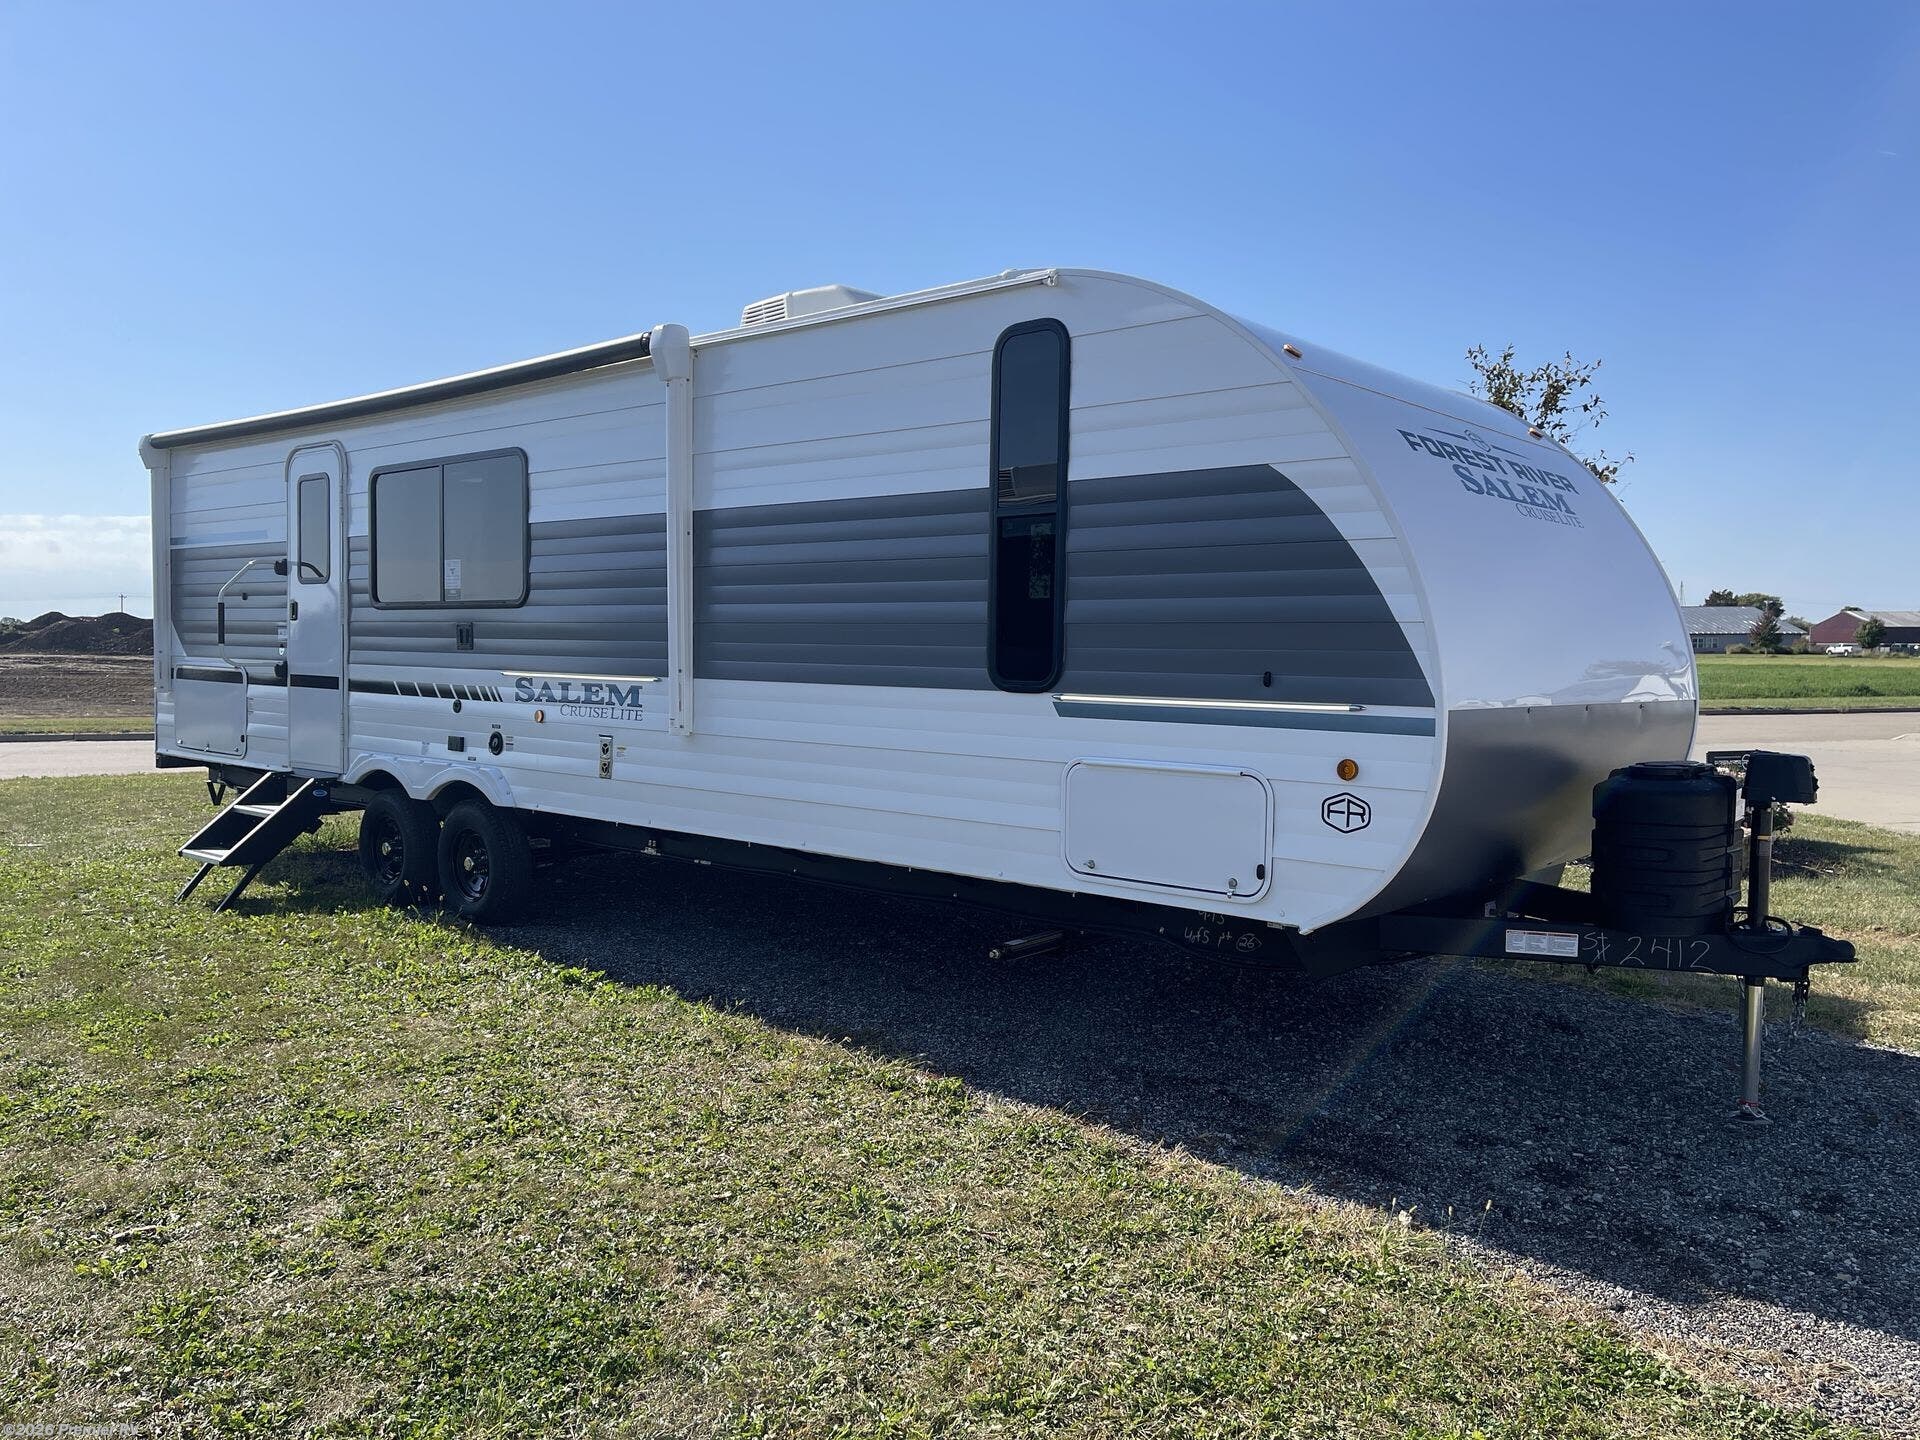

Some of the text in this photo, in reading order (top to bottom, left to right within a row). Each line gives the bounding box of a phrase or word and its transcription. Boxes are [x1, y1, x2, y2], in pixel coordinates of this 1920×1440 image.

[1396, 429, 1580, 495] FOREST RIVER
[1452, 463, 1576, 515] SALEM
[514, 677, 643, 708] SALEM
[560, 703, 644, 722] CRUISELITE
[1619, 937, 1717, 974] 2412
